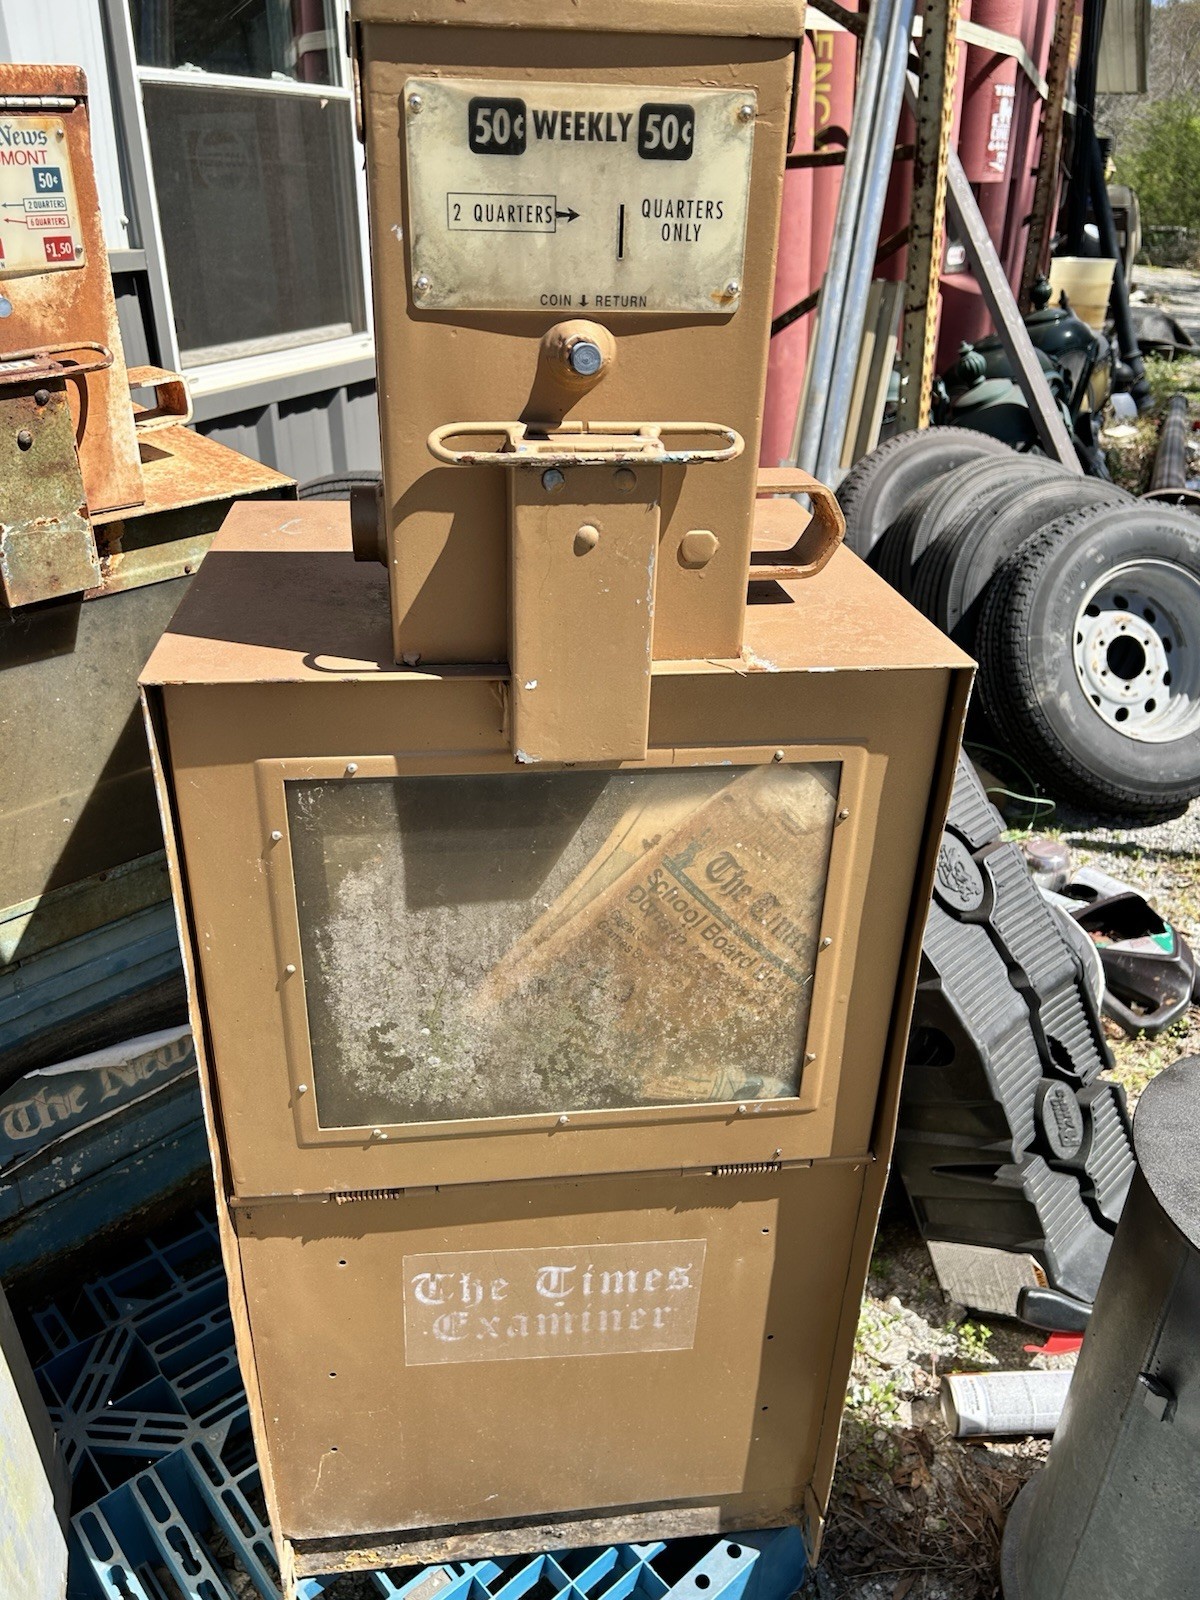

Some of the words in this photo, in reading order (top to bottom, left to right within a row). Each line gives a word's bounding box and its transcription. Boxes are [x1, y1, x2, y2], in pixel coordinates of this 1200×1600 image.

[0, 124, 48, 147] News
[474, 108, 525, 146] 50¢
[532, 109, 634, 143] WEEKLY
[644, 114, 693, 151] 50¢
[38, 171, 58, 189] 50¢
[28, 201, 33, 210] 2
[33, 199, 65, 209] QUARTERS
[453, 203, 462, 222] 2
[473, 203, 553, 224] QUARTERS
[641, 198, 725, 220] QUARTERS
[30, 218, 35, 226] 6
[36, 216, 66, 226] QUARTERS
[661, 223, 702, 242] ONLY
[46, 242, 72, 258] $1.50
[540, 294, 572, 307] COIN
[595, 295, 647, 308] RETURN
[705, 850, 752, 899] The
[647, 868, 709, 929] School
[700, 921, 758, 969] Board
[0, 1082, 89, 1141] The
[410, 1271, 510, 1309] The
[535, 1262, 694, 1299] Times
[432, 1303, 673, 1343] Examiner
